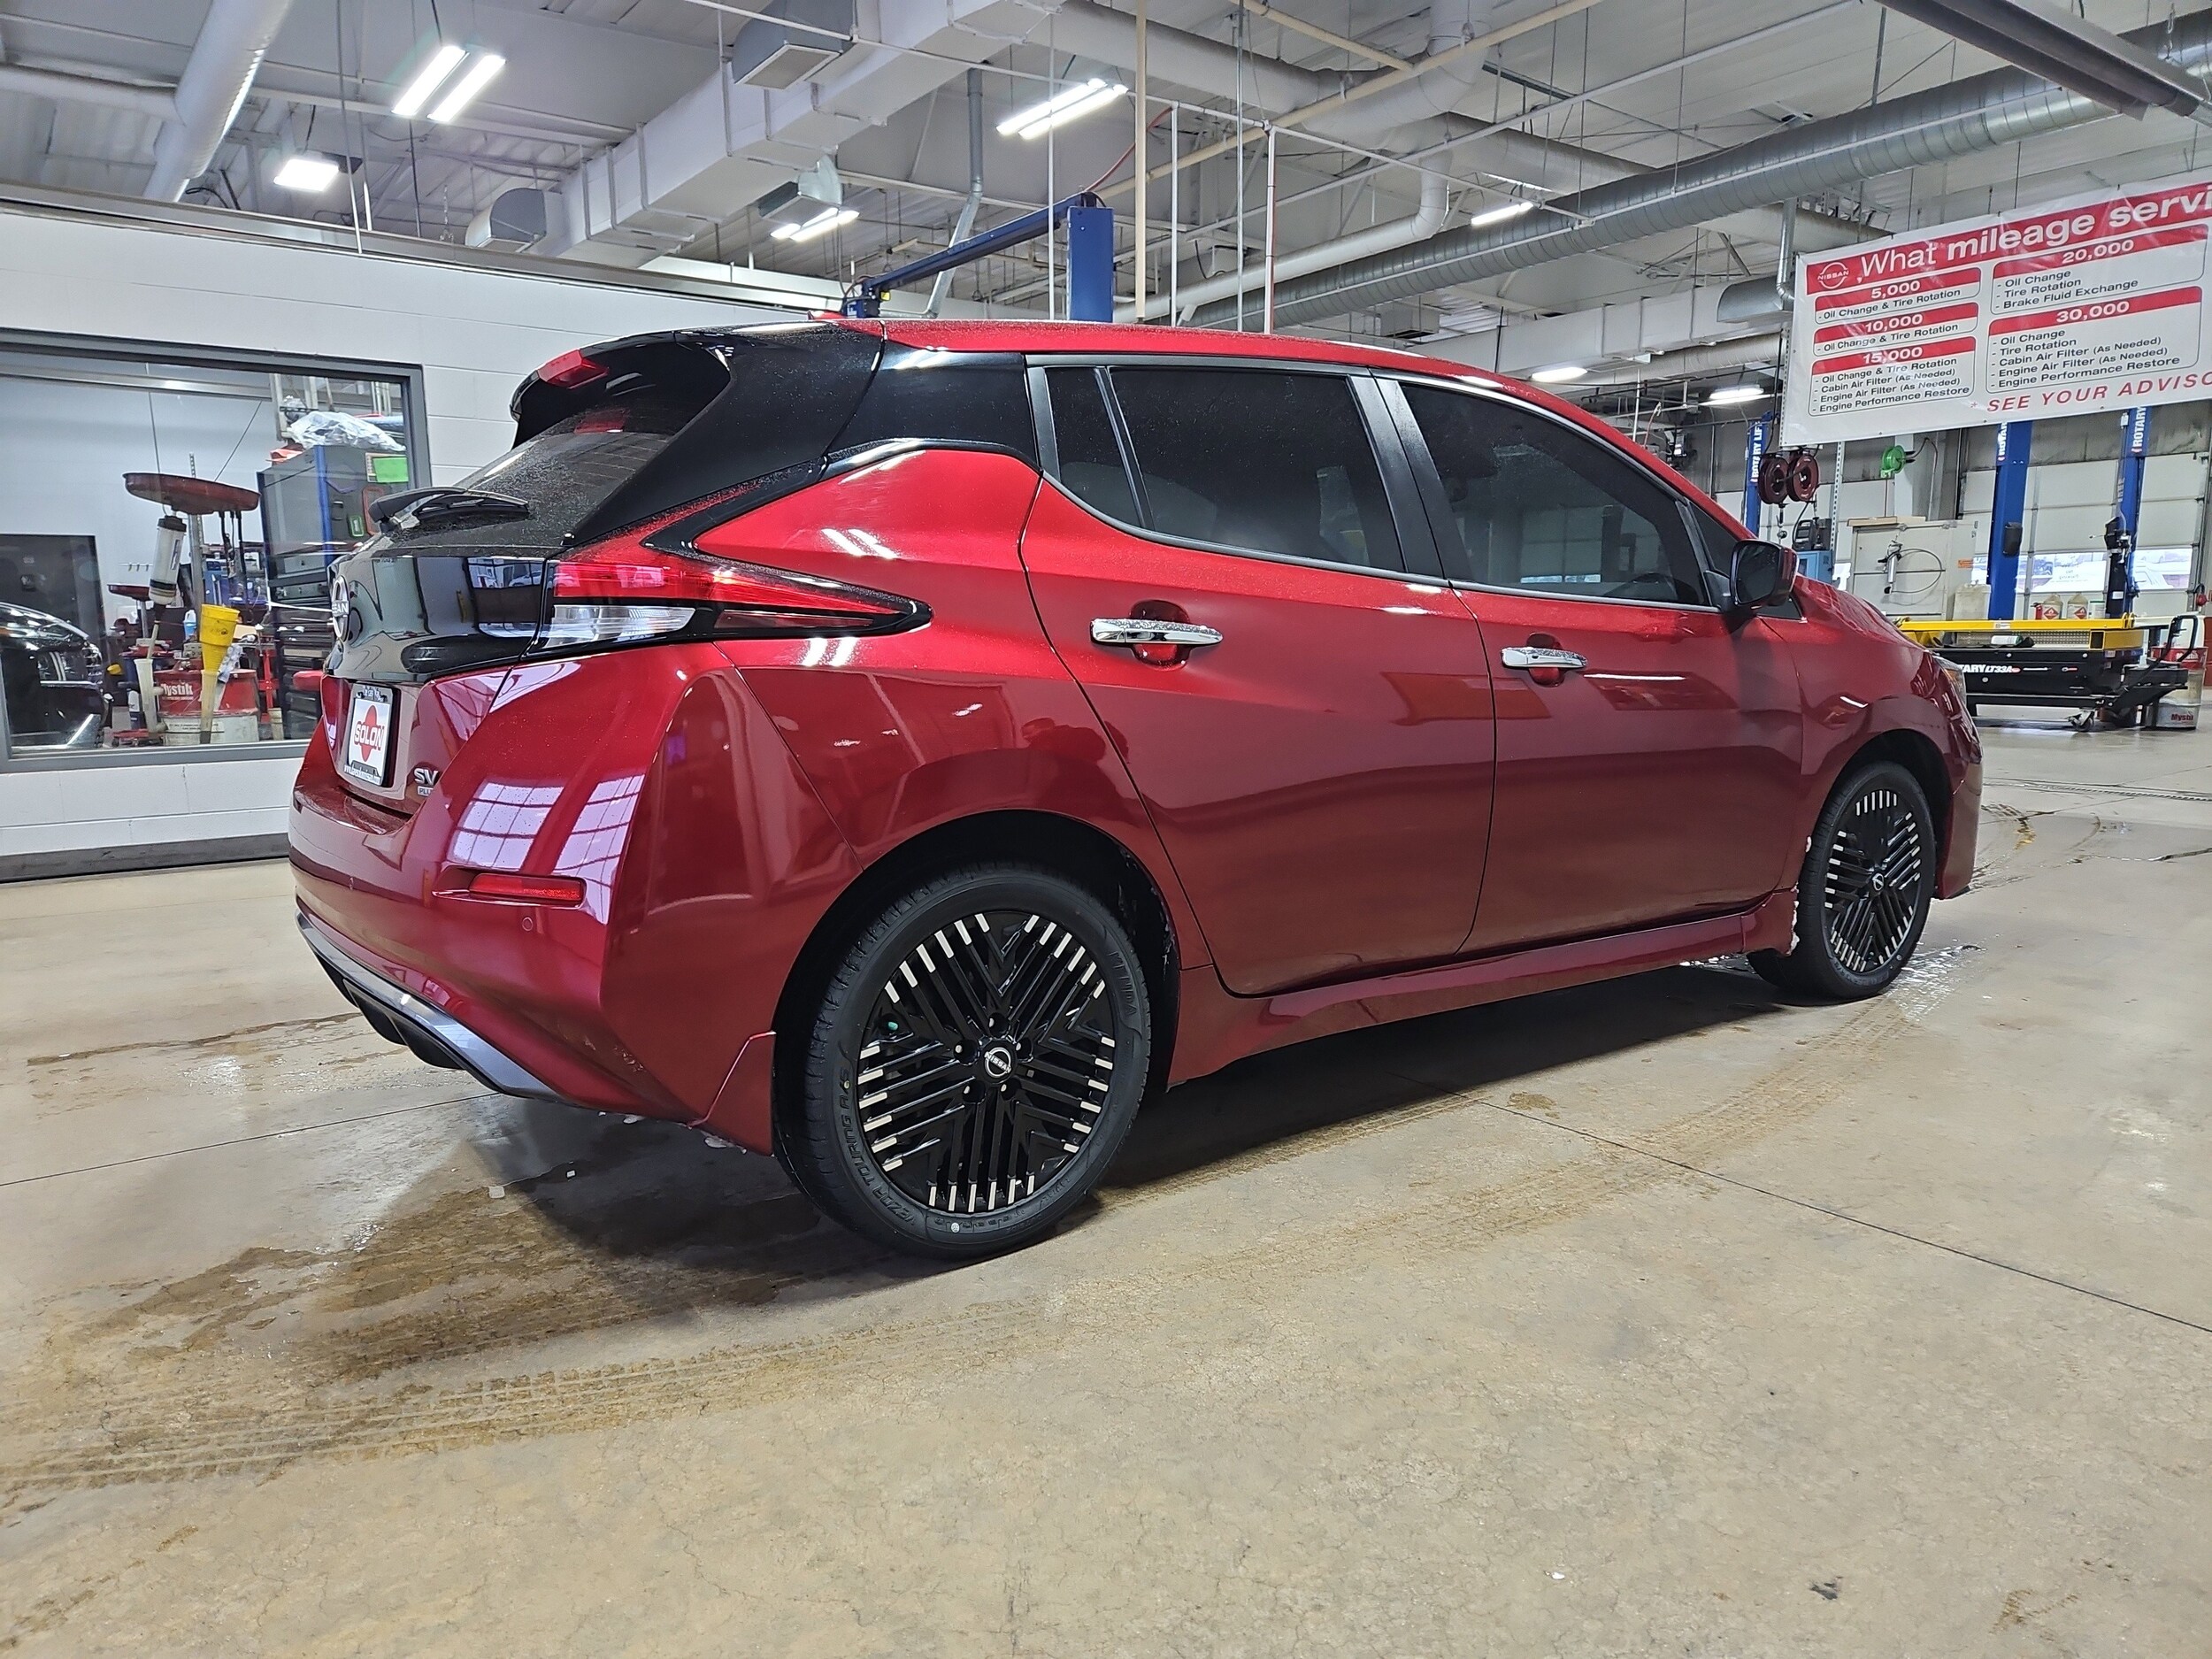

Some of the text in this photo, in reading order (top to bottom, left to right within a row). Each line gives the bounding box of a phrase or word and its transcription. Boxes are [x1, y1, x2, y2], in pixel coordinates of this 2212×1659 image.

[1861, 242, 1937, 278] What
[1948, 212, 2095, 261] mileage
[2062, 239, 2134, 265] 20,000
[1817, 269, 1849, 280] NISSAN
[2005, 270, 2071, 288] Oil Change
[1871, 280, 1921, 299] 5,000
[2003, 280, 2139, 310] Brake Fluid Exchange
[2004, 278, 2081, 299] Tire Rotation
[1824, 311, 1836, 319] Oil
[1839, 303, 1878, 318] Change
[1893, 297, 1913, 308] Tire
[1916, 288, 1961, 303] Rotation
[2055, 301, 2130, 323] 30,000
[1865, 313, 1924, 334] 10,000
[1824, 343, 1836, 352] Oil
[1837, 338, 1876, 349] Change
[1891, 331, 1910, 341] Tire
[1914, 323, 1958, 337] Rotation
[2000, 338, 2077, 357] Tire Rotation
[2001, 329, 2066, 346] Oil Change
[1863, 346, 1924, 365] 15,000
[1999, 336, 2162, 367] Cabin Air Filter (As Needed)
[1999, 347, 2168, 379] Engine Air Filter (As Needed)
[1821, 368, 1955, 394] Cabin Air Filter (As Needed)
[1822, 374, 1835, 384] Oil
[1837, 369, 1872, 382] Change
[1886, 364, 1908, 373] Tire
[1911, 357, 1957, 371] Rotation
[1998, 357, 2180, 389] Engine Performance Restore
[1819, 386, 1970, 414] Engine Performance Restore
[1820, 377, 1961, 403] Engine Air Filter (As Needed)
[1987, 395, 2031, 412] SEE
[2041, 385, 2108, 406] YOUR
[354, 721, 385, 751] SOLON
[413, 767, 439, 786] SV
[984, 1051, 1012, 1074] NISSAN
[841, 1115, 875, 1187] TOURING
